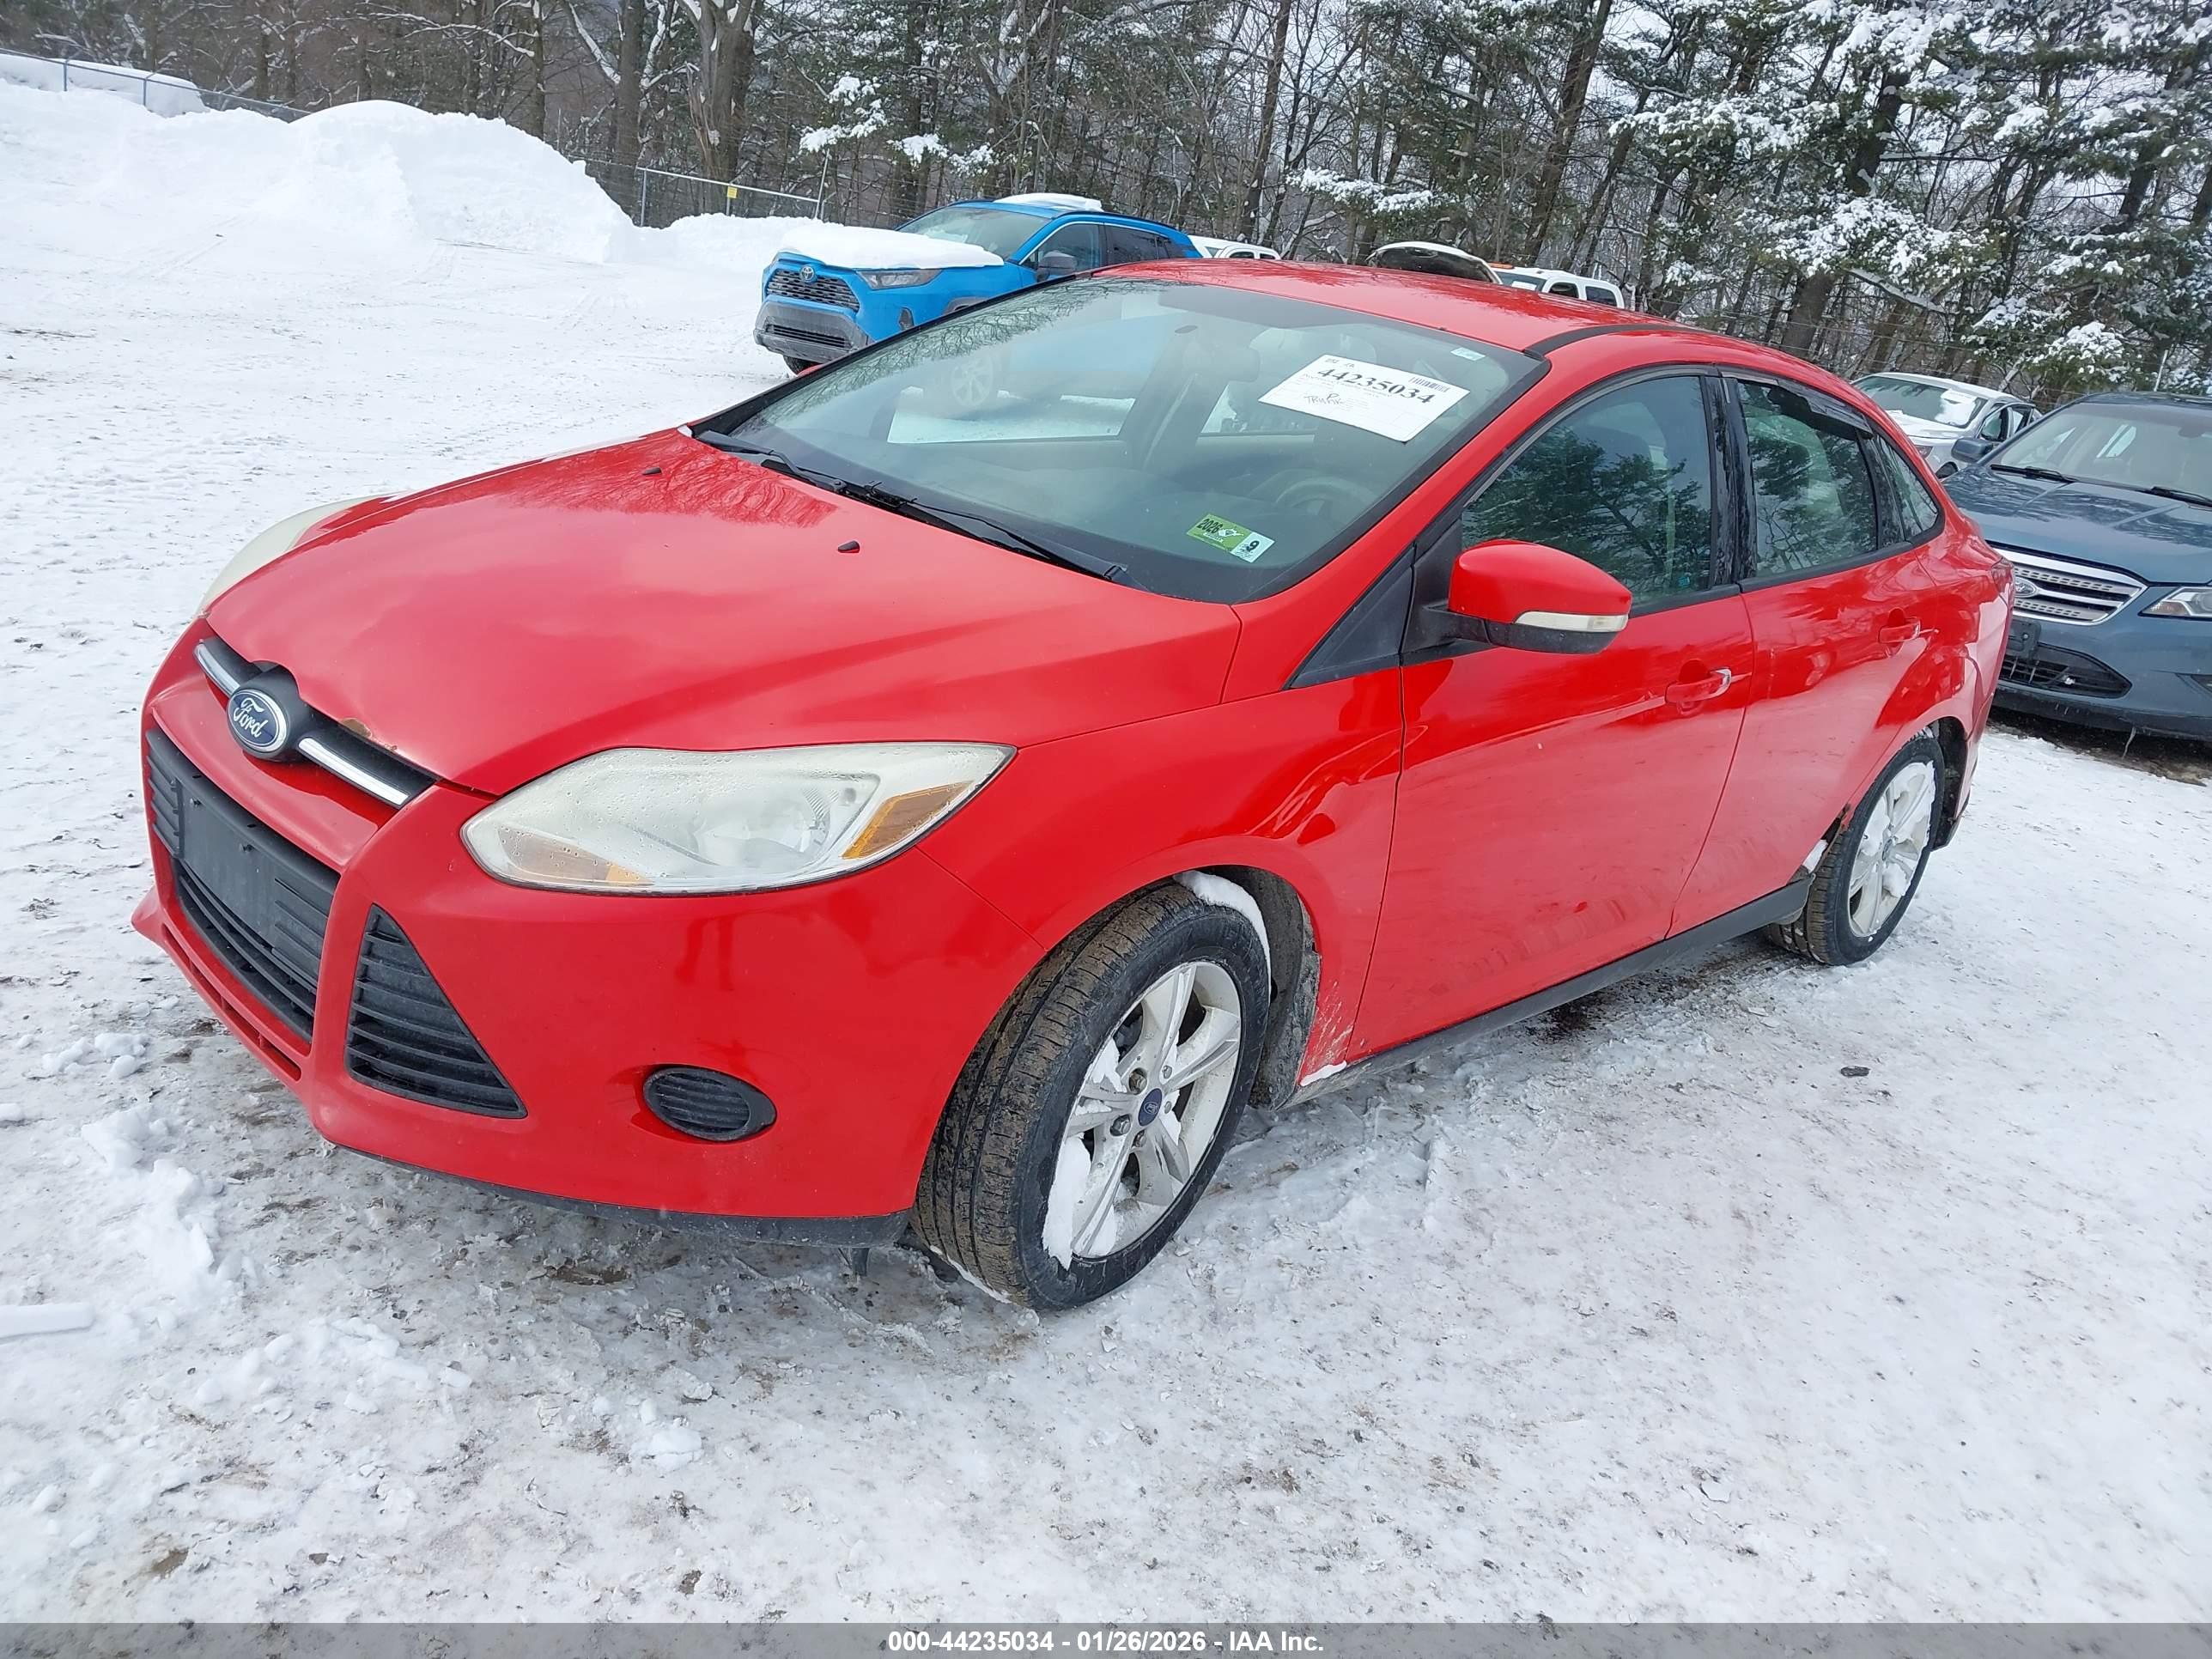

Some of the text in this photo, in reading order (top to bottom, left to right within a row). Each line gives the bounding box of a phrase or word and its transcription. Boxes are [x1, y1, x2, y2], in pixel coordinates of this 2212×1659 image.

[1317, 368, 1435, 404] 44235034
[1246, 540, 1260, 552] 9
[233, 697, 269, 738] Ford
